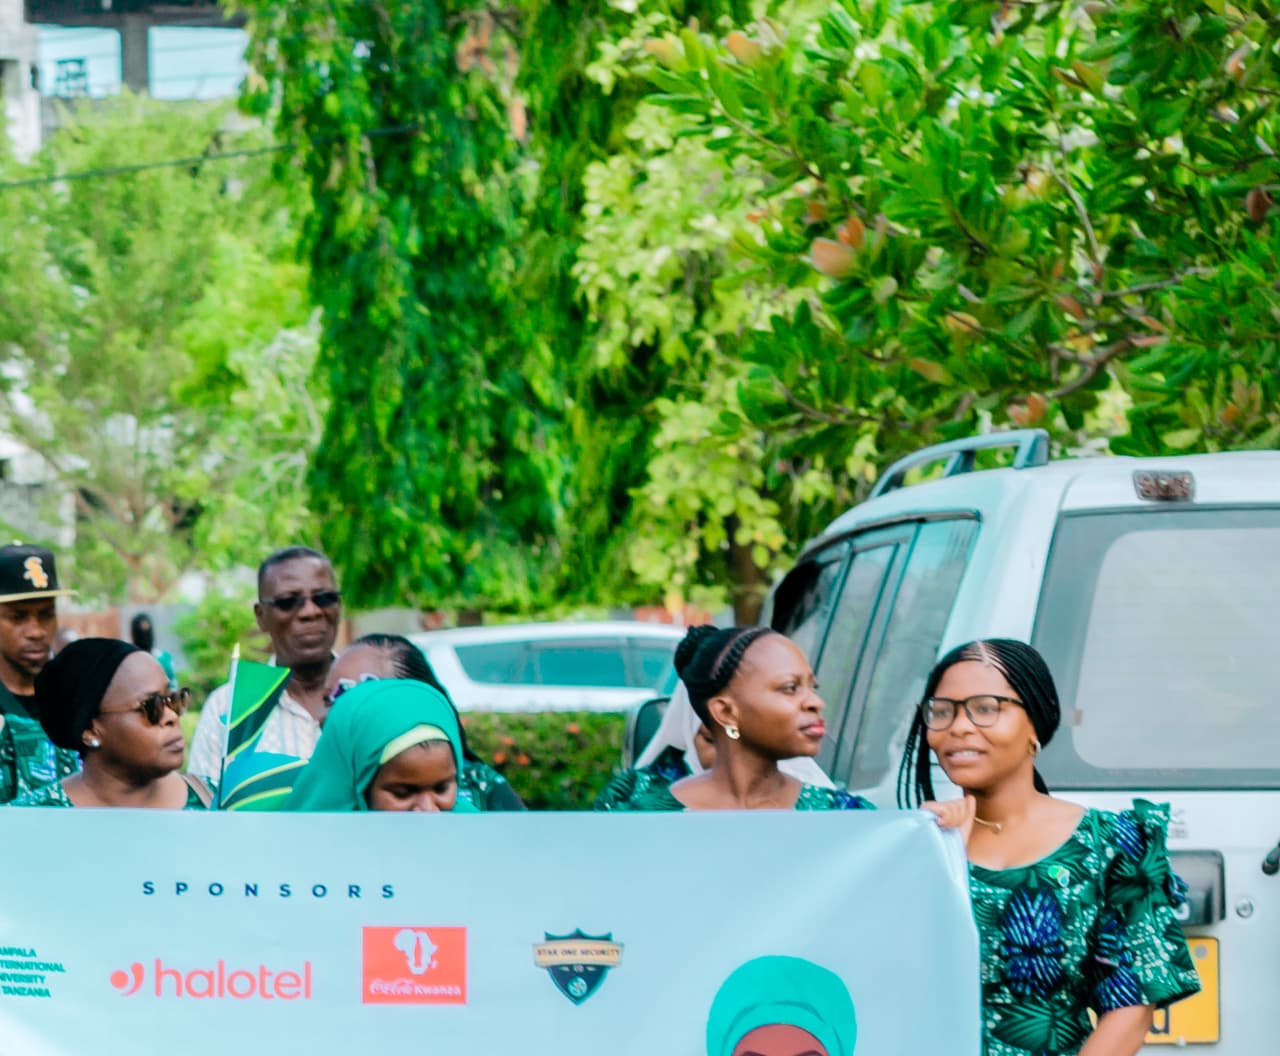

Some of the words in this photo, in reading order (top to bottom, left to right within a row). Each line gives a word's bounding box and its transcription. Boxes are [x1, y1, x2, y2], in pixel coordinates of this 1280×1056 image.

[142, 881, 395, 899] SPONSORS
[154, 958, 312, 1000] halotel
[2, 985, 52, 998] TANZANIA
